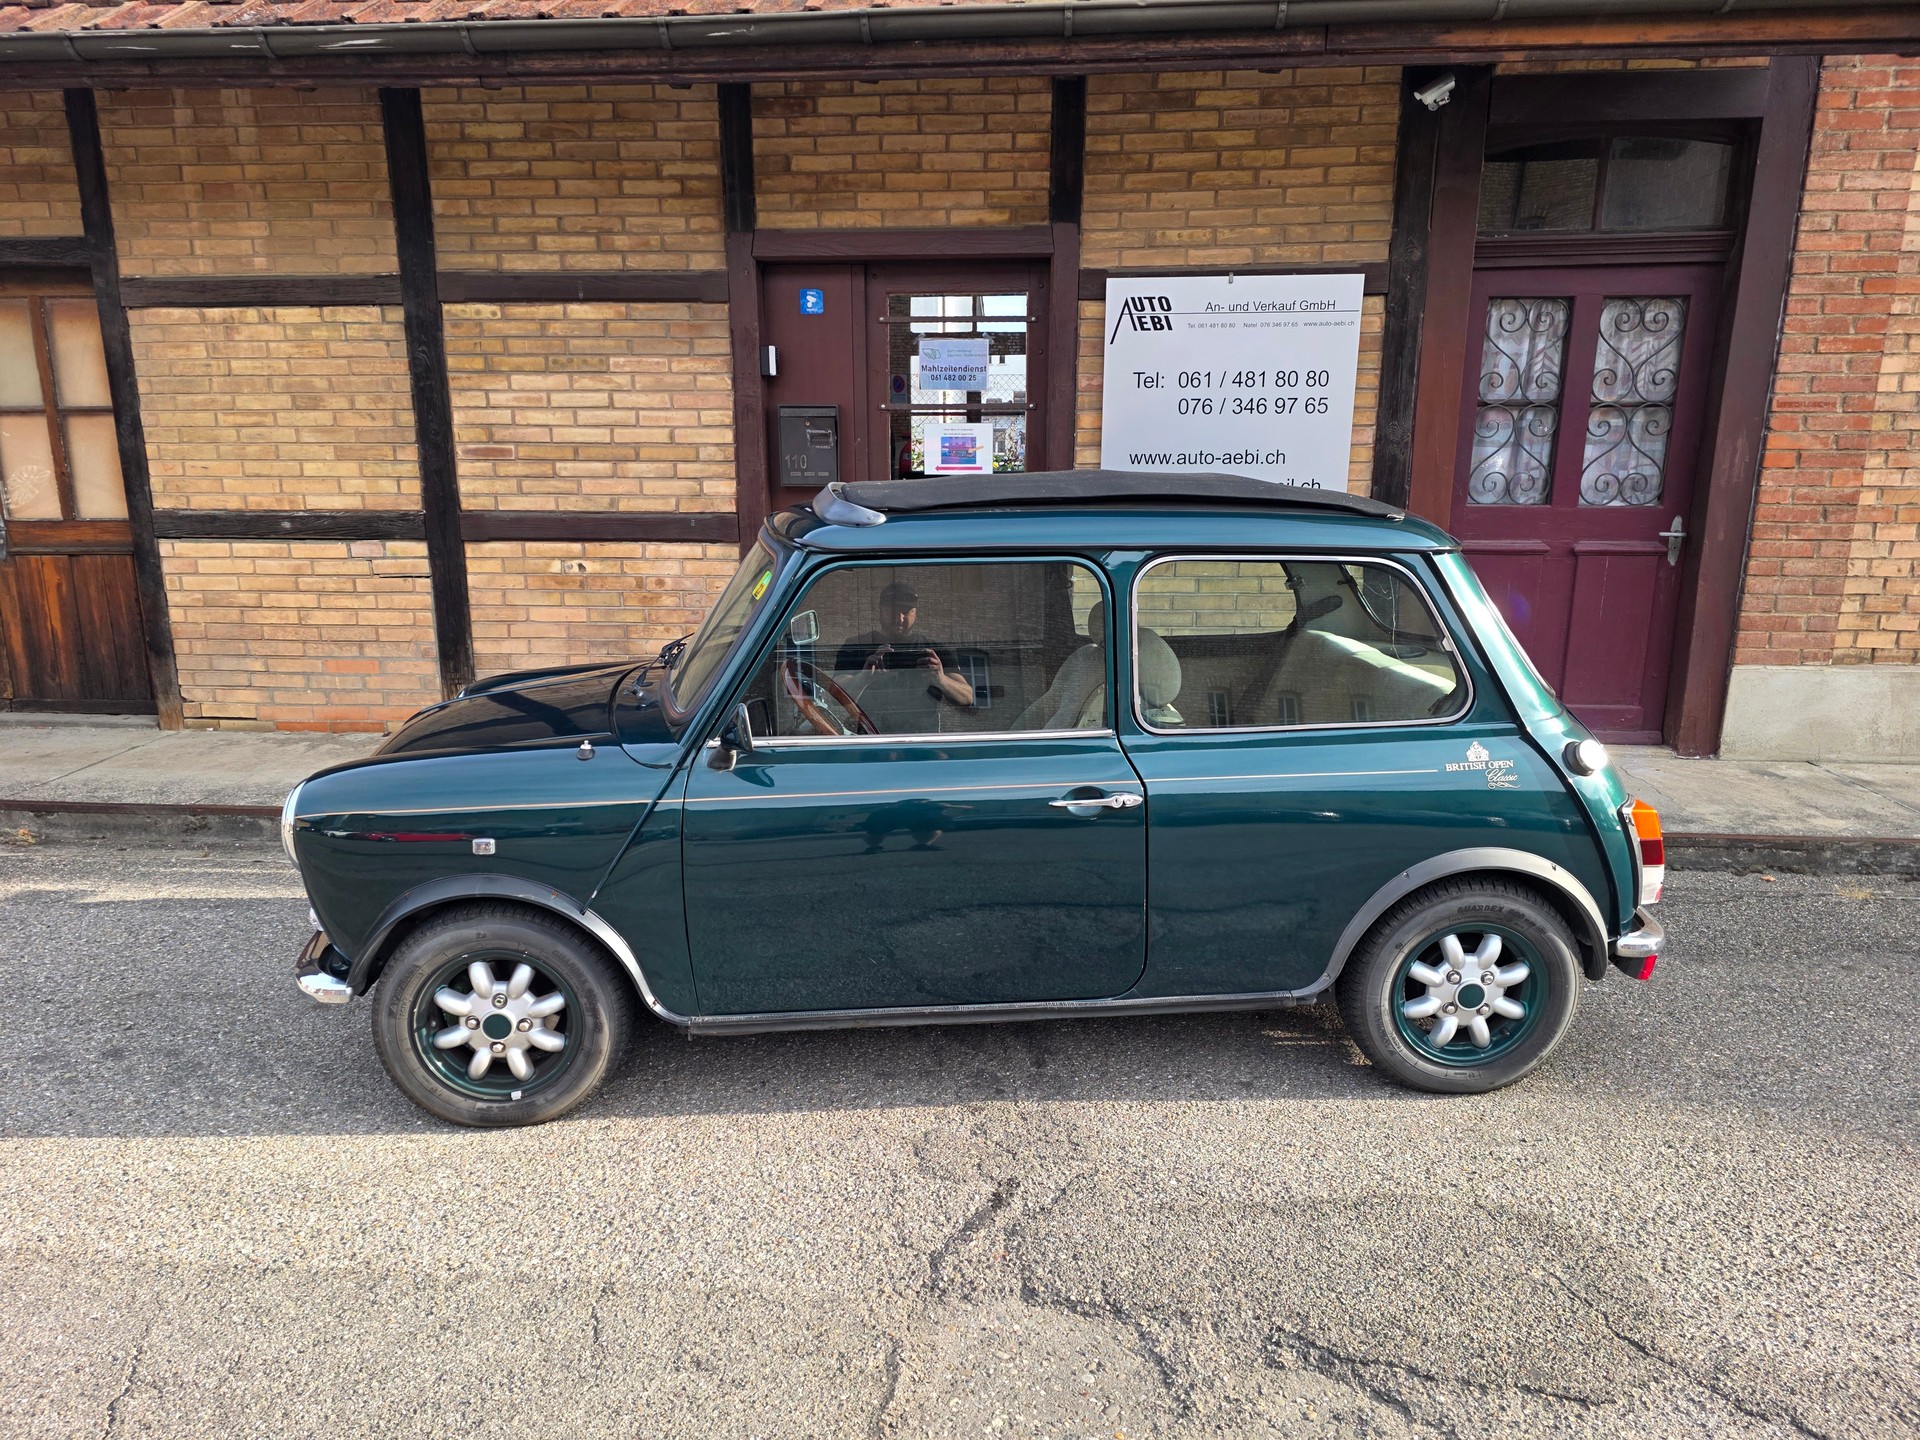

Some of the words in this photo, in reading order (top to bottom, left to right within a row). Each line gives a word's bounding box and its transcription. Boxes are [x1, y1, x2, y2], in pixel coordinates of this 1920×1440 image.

[1205, 301, 1225, 312] An-
[1228, 301, 1249, 312] und
[1253, 300, 1296, 311] Verkauf
[1300, 299, 1336, 310] GmbH
[1303, 319, 1355, 327] www.auto-aebi.ch
[921, 364, 987, 373] Mahlzeitendienst
[1133, 372, 1165, 388] Tel:
[1178, 371, 1211, 388] 061
[1219, 371, 1227, 388] /
[1231, 370, 1266, 388] 481
[1274, 370, 1299, 388] 80
[1305, 370, 1330, 387] 80
[1178, 398, 1213, 415] 076
[1219, 397, 1227, 415] /
[1232, 398, 1267, 415] 346
[1274, 397, 1298, 414] 97
[1304, 397, 1329, 414] 65
[785, 454, 807, 470] 110
[1129, 449, 1286, 465] www.auto-aebi.ch
[1445, 762, 1486, 772] BRITISH
[1488, 760, 1514, 769] OPEN
[1485, 768, 1518, 782] Classic
